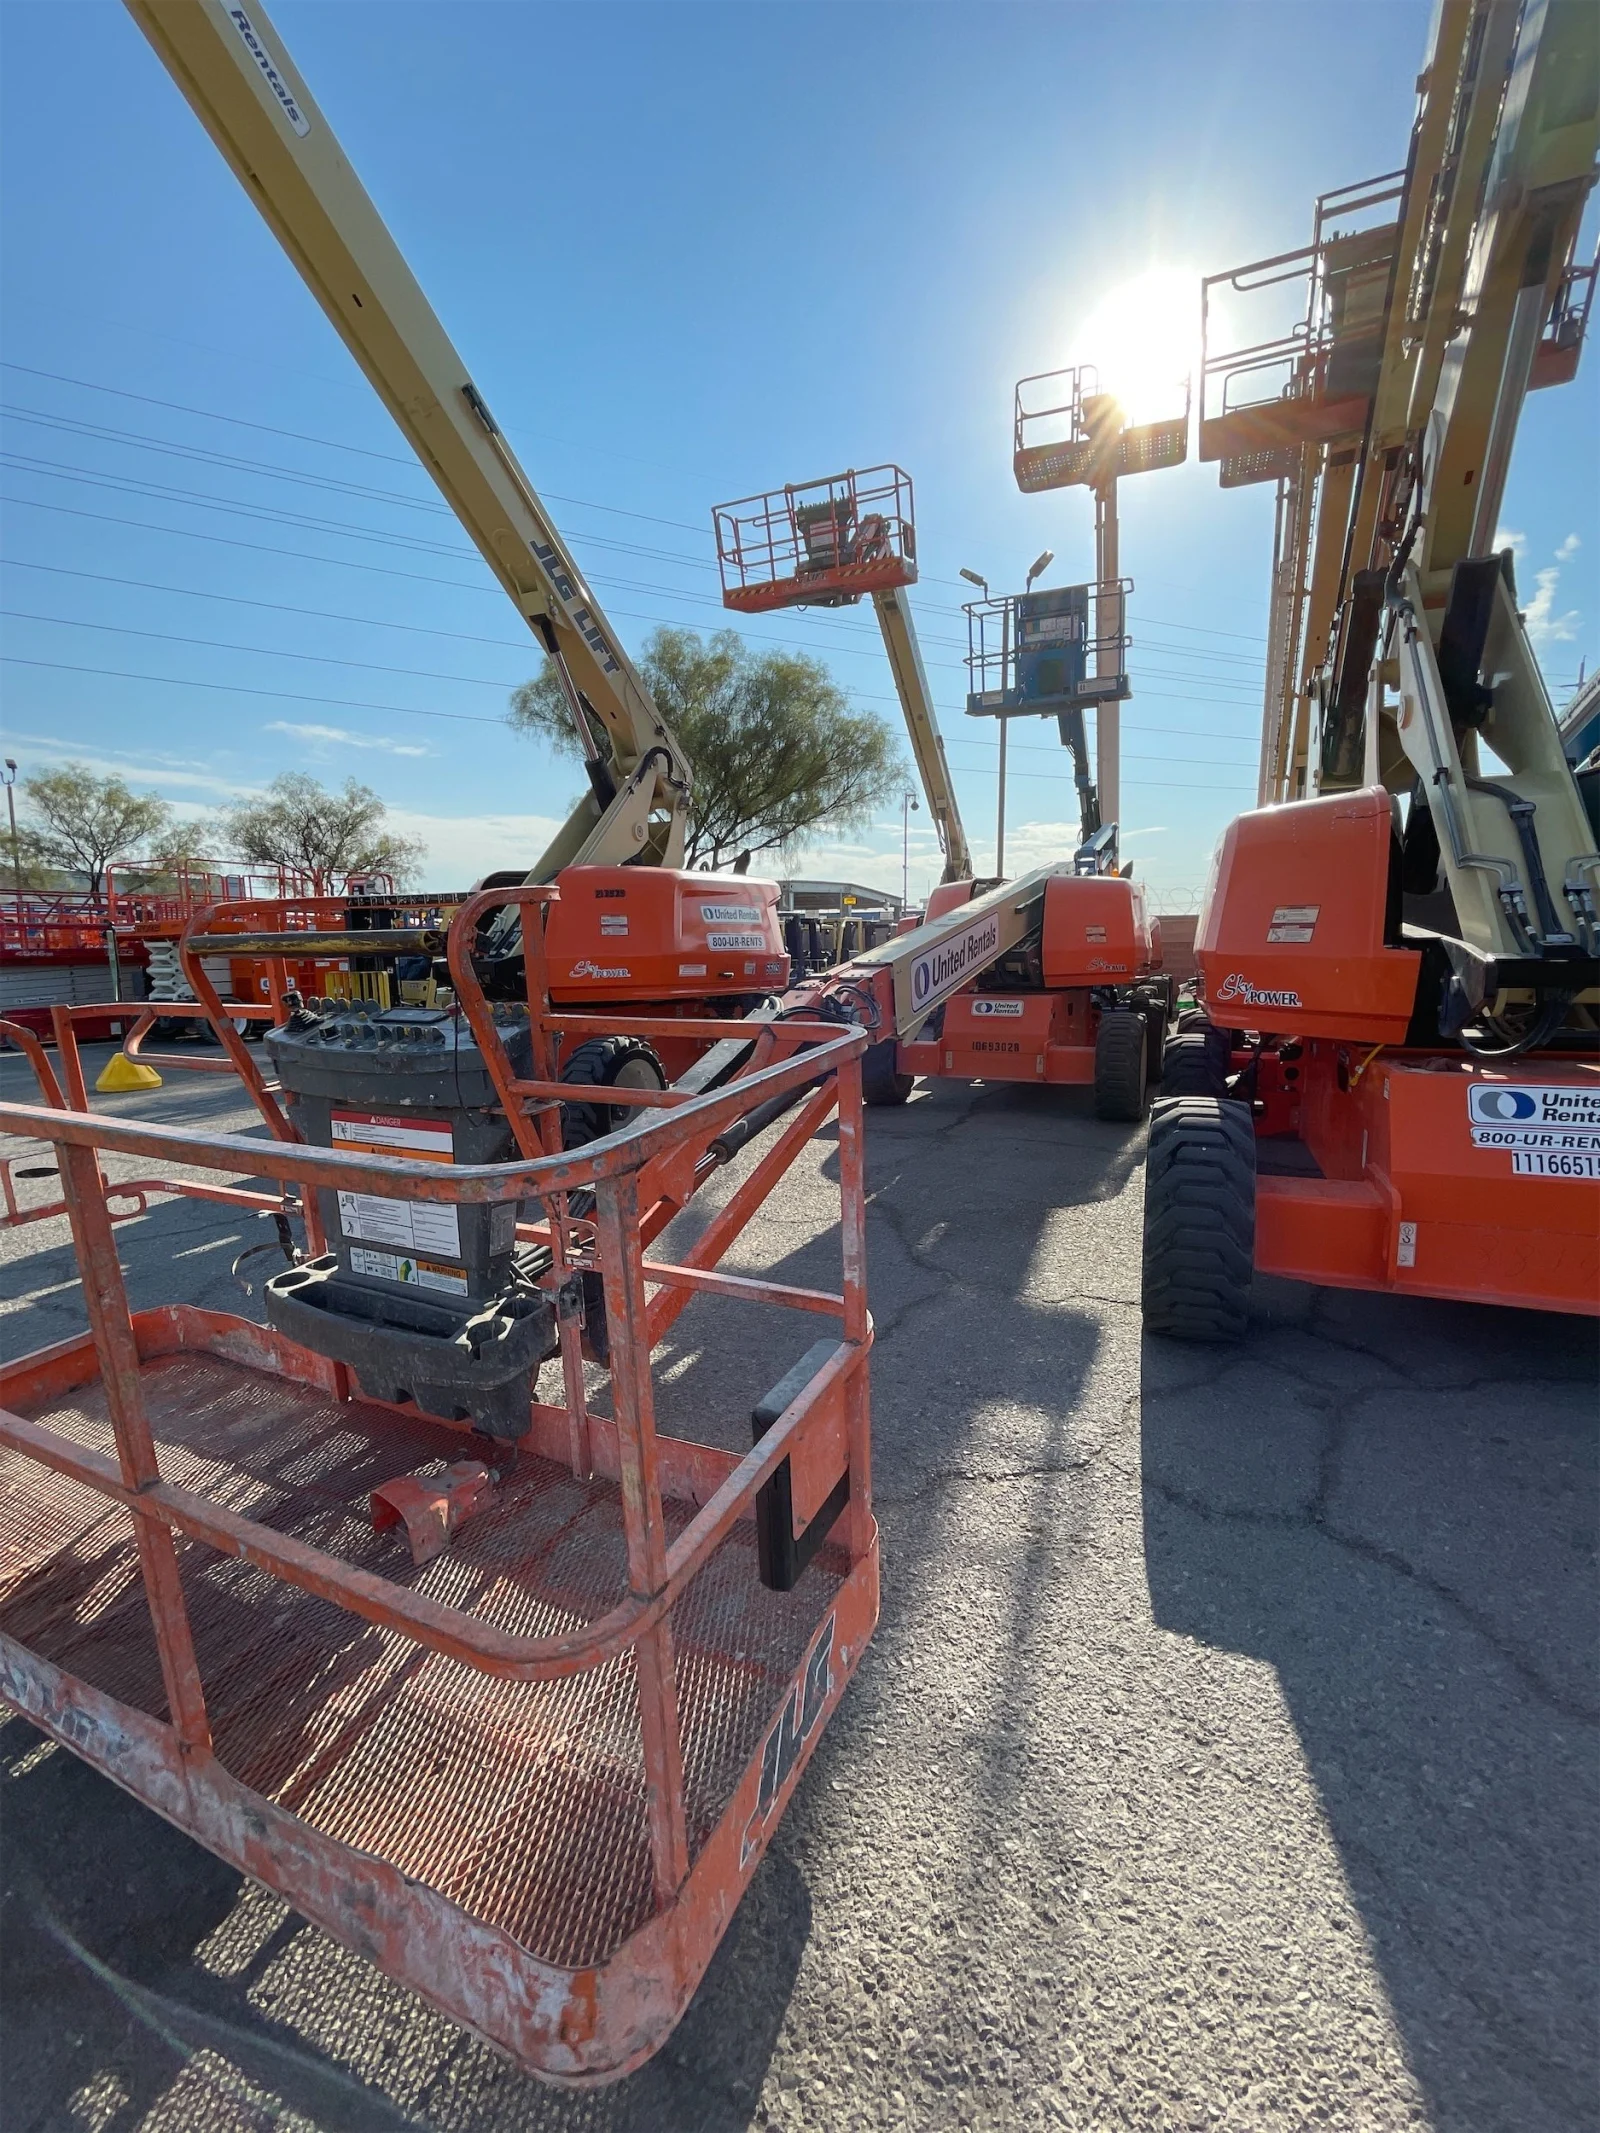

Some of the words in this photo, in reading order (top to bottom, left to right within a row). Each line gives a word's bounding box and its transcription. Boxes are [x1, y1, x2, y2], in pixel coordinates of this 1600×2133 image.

[231, 10, 300, 122] Rentals
[529, 540, 577, 602] JLG
[572, 608, 621, 674] LIFT
[714, 908, 738, 920] United
[738, 909, 760, 921] Rentals
[712, 936, 763, 947] 800-UR-RENTS
[932, 939, 966, 987] United
[967, 922, 996, 963] Rentals
[376, 1115, 401, 1127] DANGER
[1512, 1152, 1600, 1177] 1116651
[431, 1264, 462, 1279] WARNING
